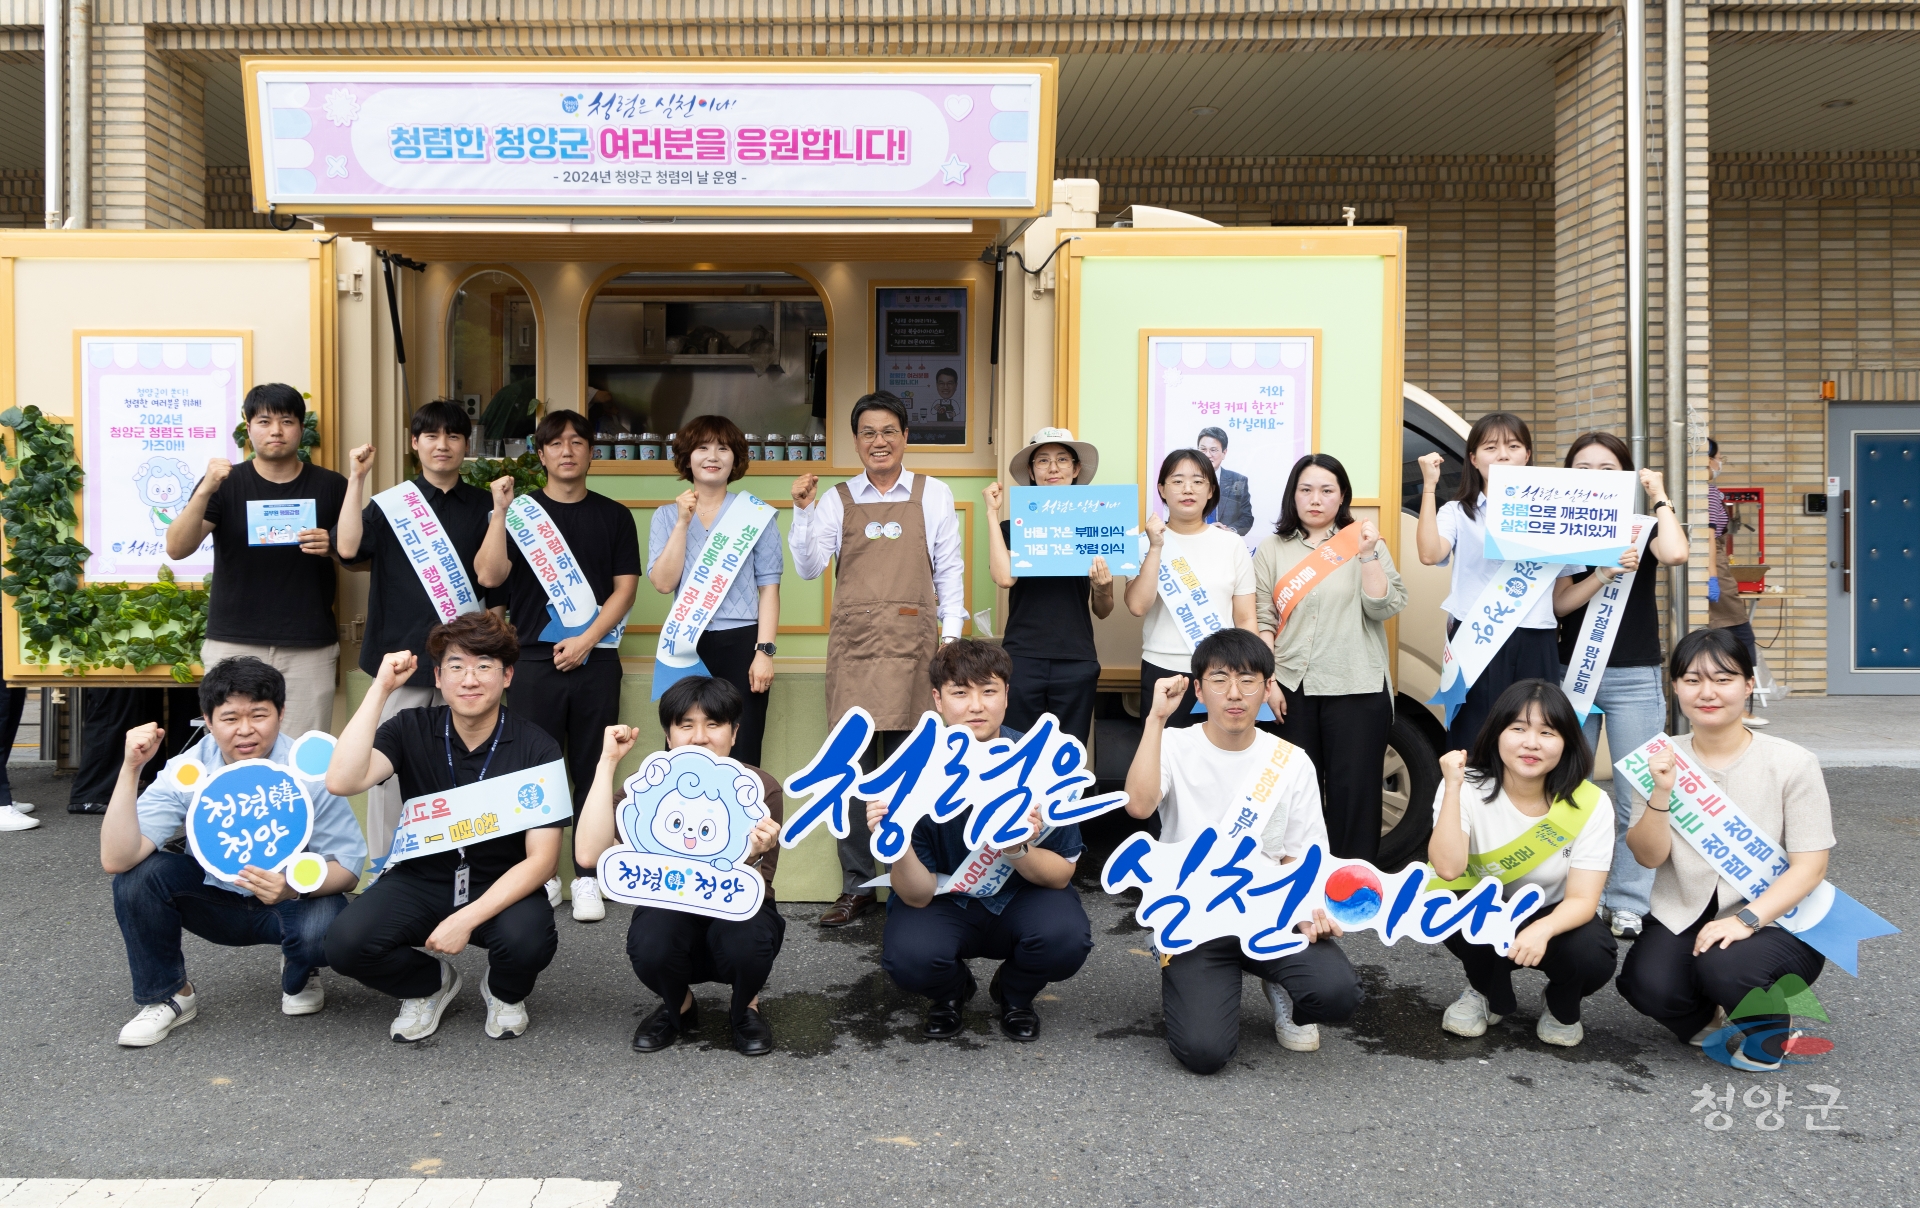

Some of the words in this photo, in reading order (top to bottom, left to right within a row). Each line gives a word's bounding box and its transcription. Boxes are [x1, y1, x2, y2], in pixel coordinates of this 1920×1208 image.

[587, 91, 653, 121] 청렴은
[389, 125, 487, 160] 청렴한
[494, 126, 590, 160] 청양군
[600, 127, 727, 161] 여러분을
[736, 127, 907, 162] 응원합니다!
[562, 169, 612, 185] 2024년
[615, 169, 653, 185] 청양군
[656, 169, 693, 185] 청렴의
[696, 169, 710, 185] 날
[712, 169, 738, 185] 운영
[124, 398, 148, 409] 청렴한
[151, 398, 180, 410] 여러분을
[182, 398, 202, 408] 위해!
[136, 387, 168, 399] 청양군이
[1259, 385, 1285, 397] 저와
[139, 413, 183, 426] 2024년
[1191, 400, 1221, 415] "청렴
[1224, 401, 1248, 413] 커피
[1251, 400, 1285, 415] 한잔"
[110, 426, 145, 439] 청양군
[149, 426, 184, 439] 청렴도
[187, 426, 217, 439] 1등급
[1228, 417, 1285, 432] 하실래요~
[141, 439, 185, 452] 가즈아!!
[1501, 502, 1557, 519] 청렴으로
[1560, 506, 1618, 523] 깨끗하게
[394, 517, 430, 564] 누리는
[1023, 526, 1049, 539] 버릴
[1049, 526, 1074, 539] 것은
[1075, 525, 1099, 538] 부패
[1100, 525, 1125, 538] 의식
[1500, 519, 1556, 535] 실천으로
[1559, 522, 1617, 539] 가치있게
[537, 520, 583, 587] 청렴하게
[693, 532, 729, 585] 행동은
[721, 524, 759, 573] 생각은
[1023, 543, 1049, 556] 가질
[1049, 543, 1074, 556] 것은
[1075, 543, 1099, 555] 청렴
[1100, 542, 1125, 555] 의식
[529, 547, 577, 615] 공정하게
[1602, 586, 1619, 601] 내
[662, 586, 700, 656] 공정하게
[682, 573, 729, 644] 청렴하게
[1590, 602, 1614, 644] 가정을
[784, 712, 1124, 858] 청렴은
[217, 818, 290, 864] 청양
[1722, 814, 1775, 863] 청렴
[1700, 832, 1753, 882] 청렴
[694, 871, 746, 904] 청양
